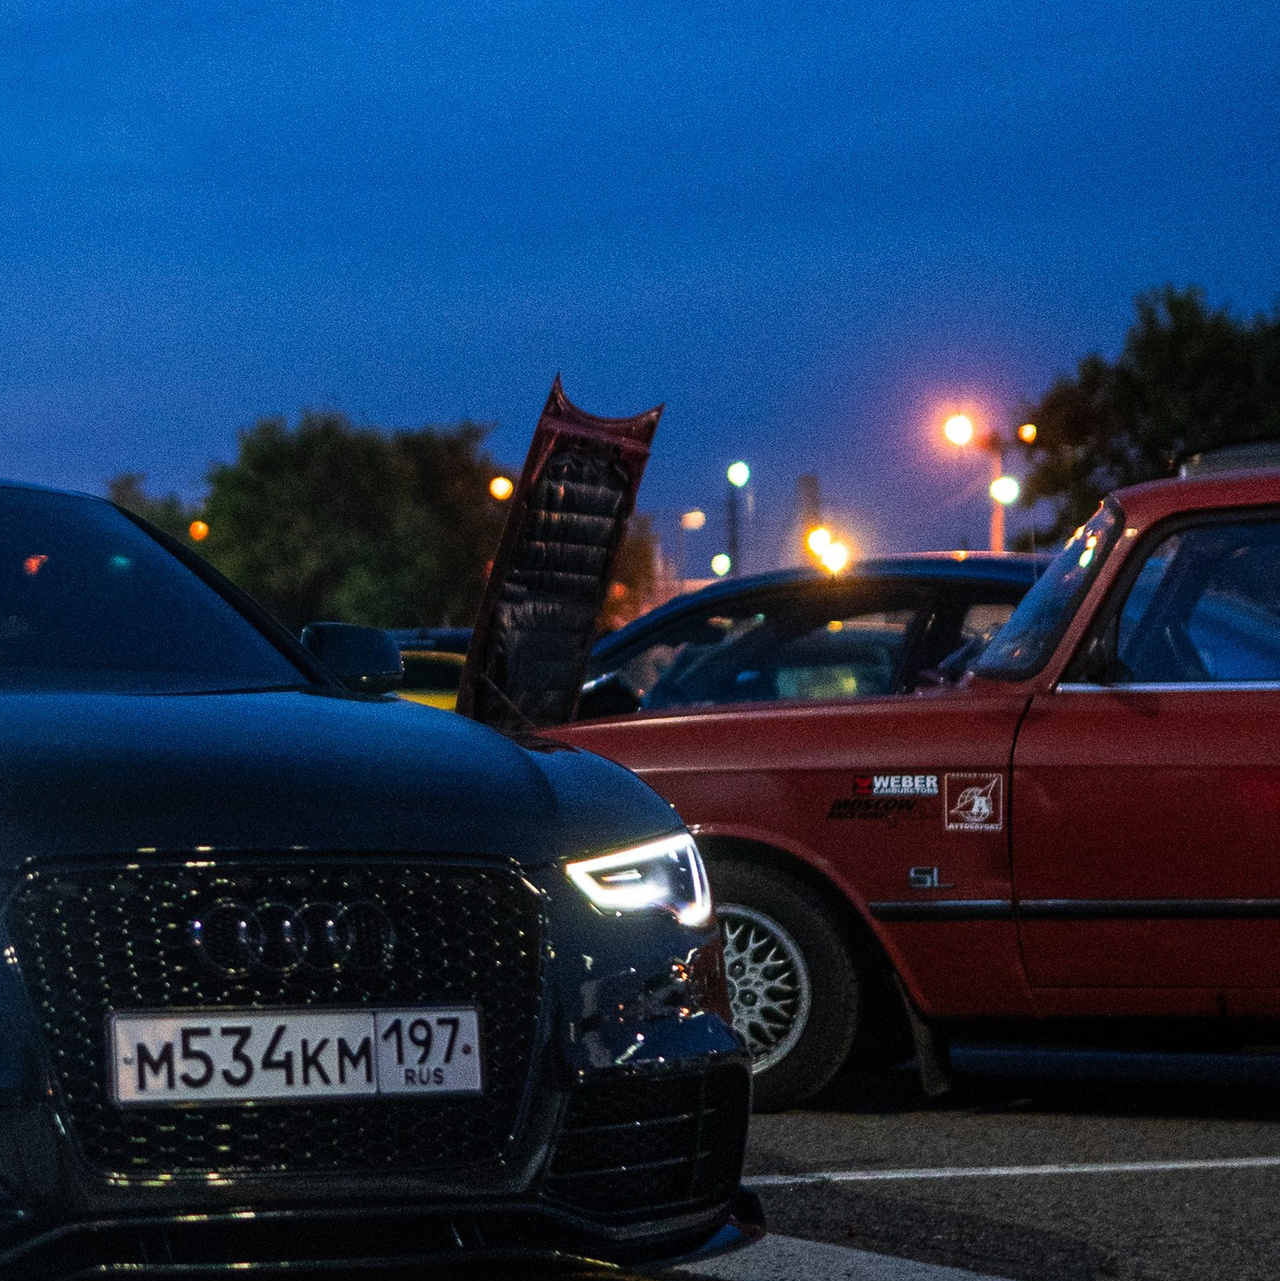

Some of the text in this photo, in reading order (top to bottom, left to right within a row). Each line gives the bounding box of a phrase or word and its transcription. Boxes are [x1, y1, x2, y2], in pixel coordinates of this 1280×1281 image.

[873, 775, 938, 788] WEBER
[381, 1017, 460, 1065] 197
[404, 1066, 445, 1086] RUS
